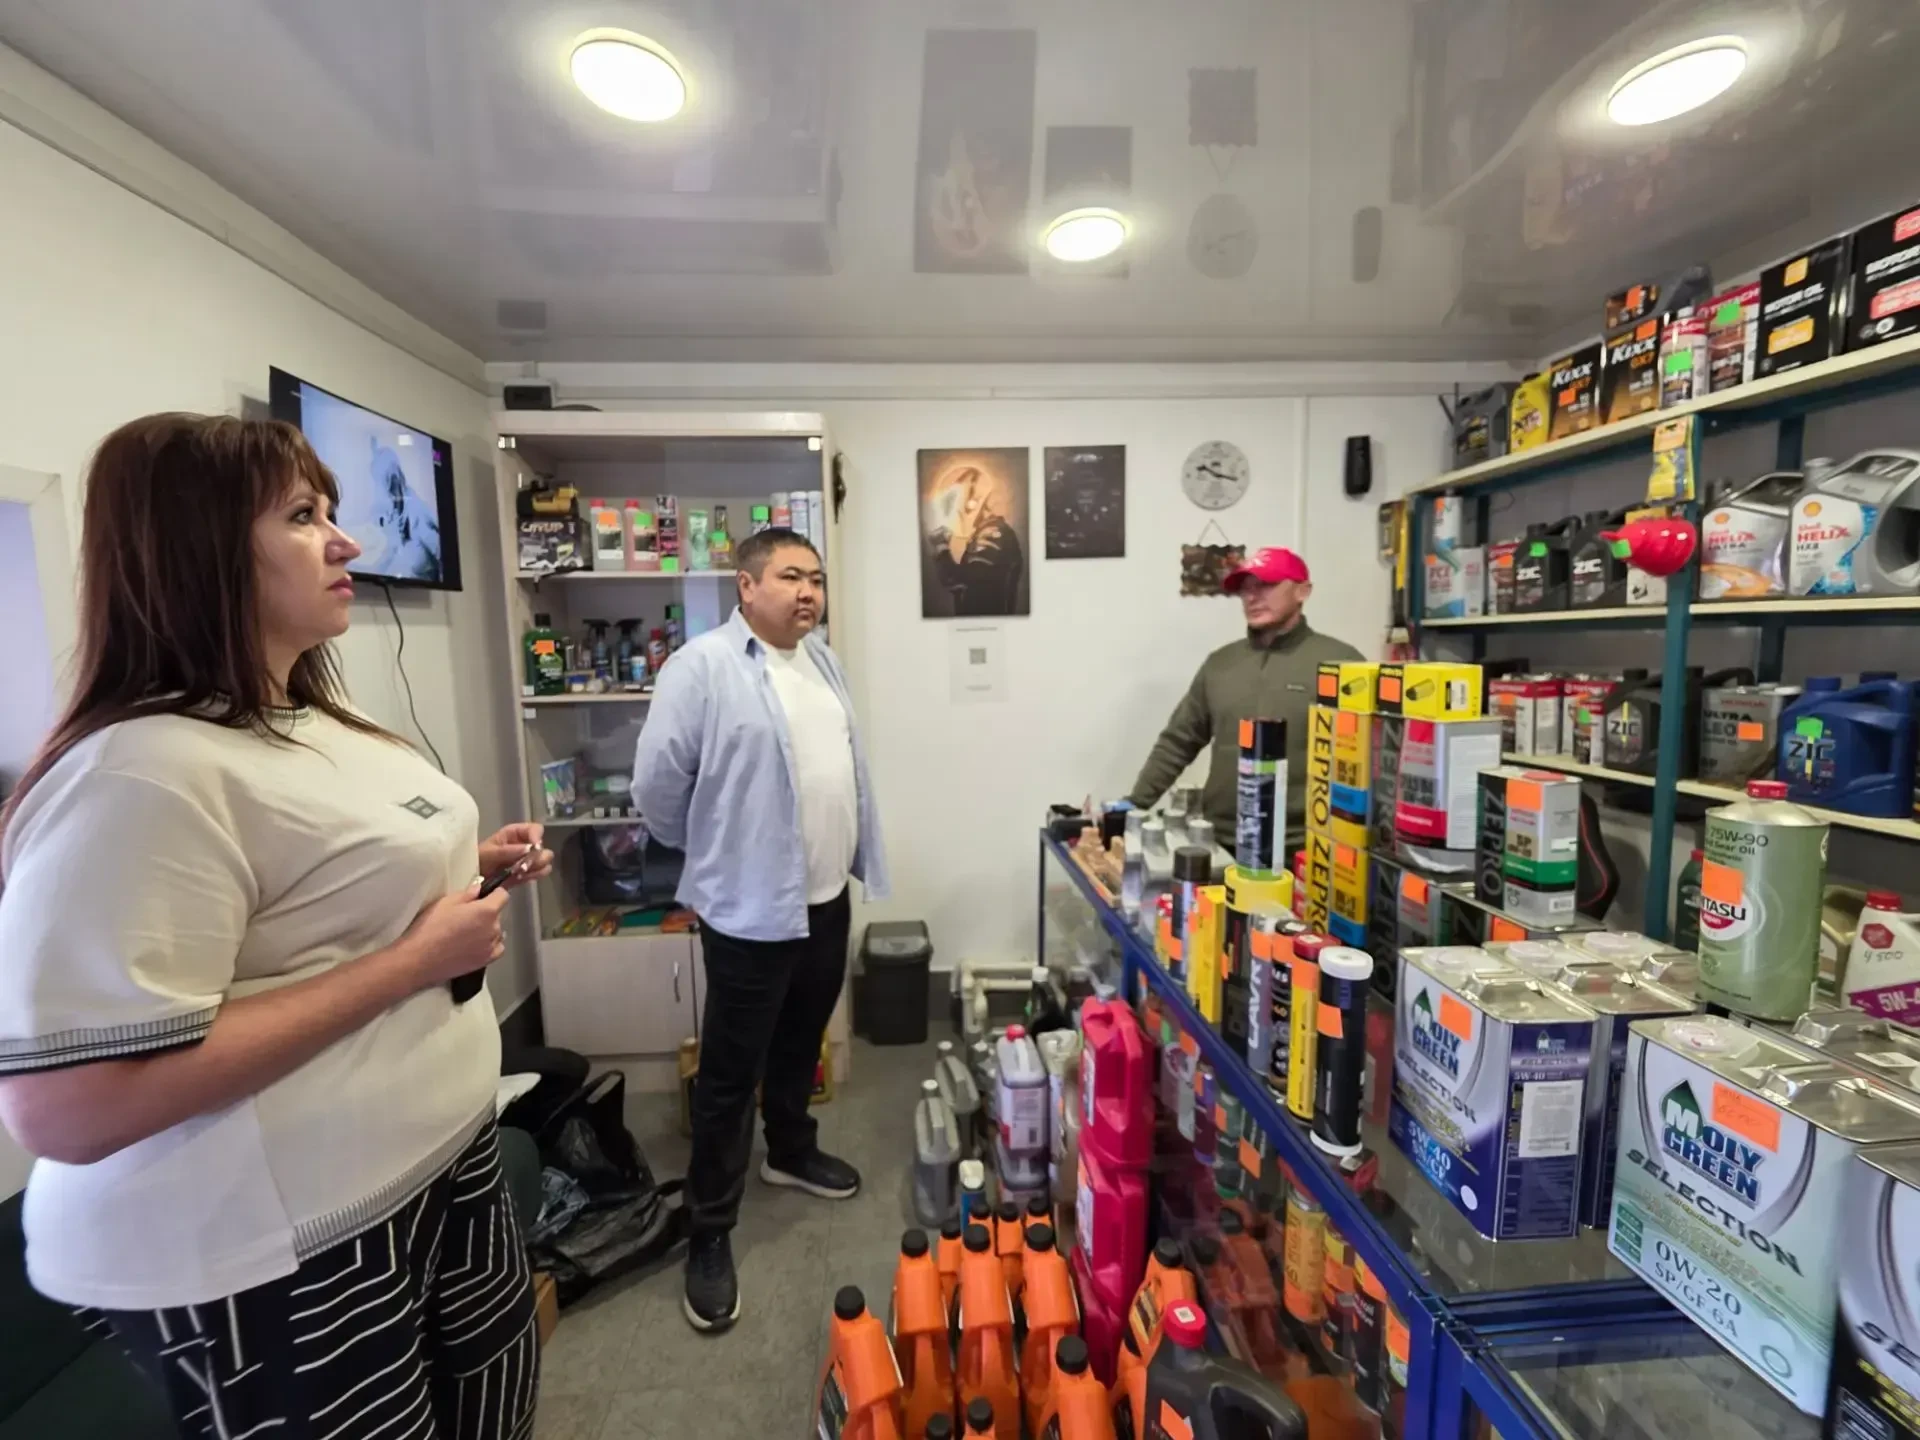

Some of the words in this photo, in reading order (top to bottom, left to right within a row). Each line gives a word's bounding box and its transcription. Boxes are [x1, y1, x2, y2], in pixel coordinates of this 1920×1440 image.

[1708, 530, 1756, 544] HELIX
[1796, 525, 1851, 542] HELIX
[1516, 566, 1543, 581] ZIC
[1573, 558, 1603, 574] ZIC
[1609, 720, 1639, 737] ZIC
[1788, 740, 1836, 761] ZIC
[1312, 711, 1333, 826] ZEPRO
[1482, 789, 1505, 896] ZEPRO
[1709, 827, 1769, 848] 75W-90
[1248, 961, 1264, 1050] LAVR
[1877, 987, 1920, 1012] 5W-4
[1412, 1029, 1461, 1078] GREEN
[1413, 1006, 1462, 1053] MOLY
[1399, 1051, 1477, 1124] SELECTION
[1666, 1097, 1763, 1174] MOLY
[1663, 1126, 1760, 1202] GREEN
[1625, 1148, 1805, 1278] SELECTION
[1655, 1240, 1742, 1316] 0W-20
